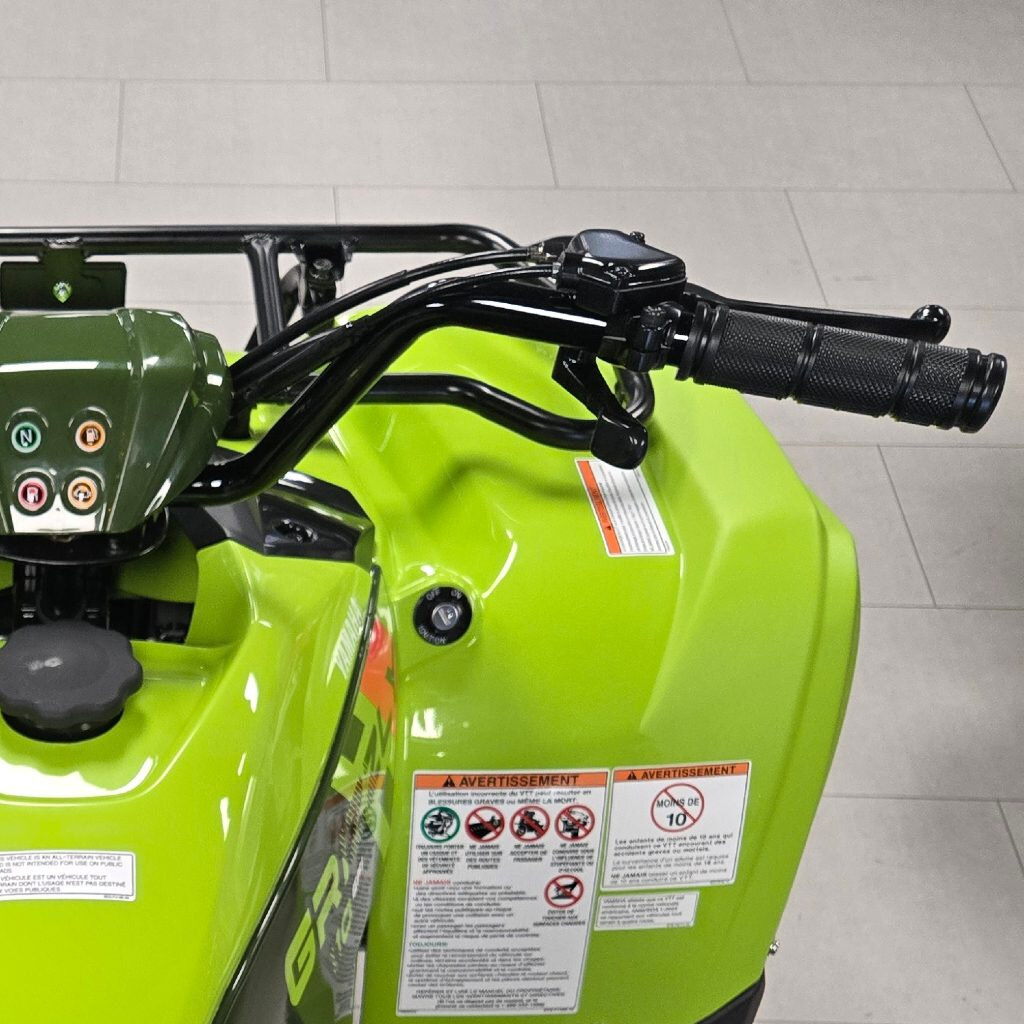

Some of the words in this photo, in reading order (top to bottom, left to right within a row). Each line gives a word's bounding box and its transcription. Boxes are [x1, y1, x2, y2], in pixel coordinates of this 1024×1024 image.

[19, 429, 33, 445] N
[425, 588, 441, 601] OFF
[641, 765, 736, 780] AVERTISSEMENT
[459, 775, 579, 787] AVERTISSEMENT
[656, 798, 685, 808] MOINS
[686, 797, 699, 806] DE
[665, 812, 687, 826] 10
